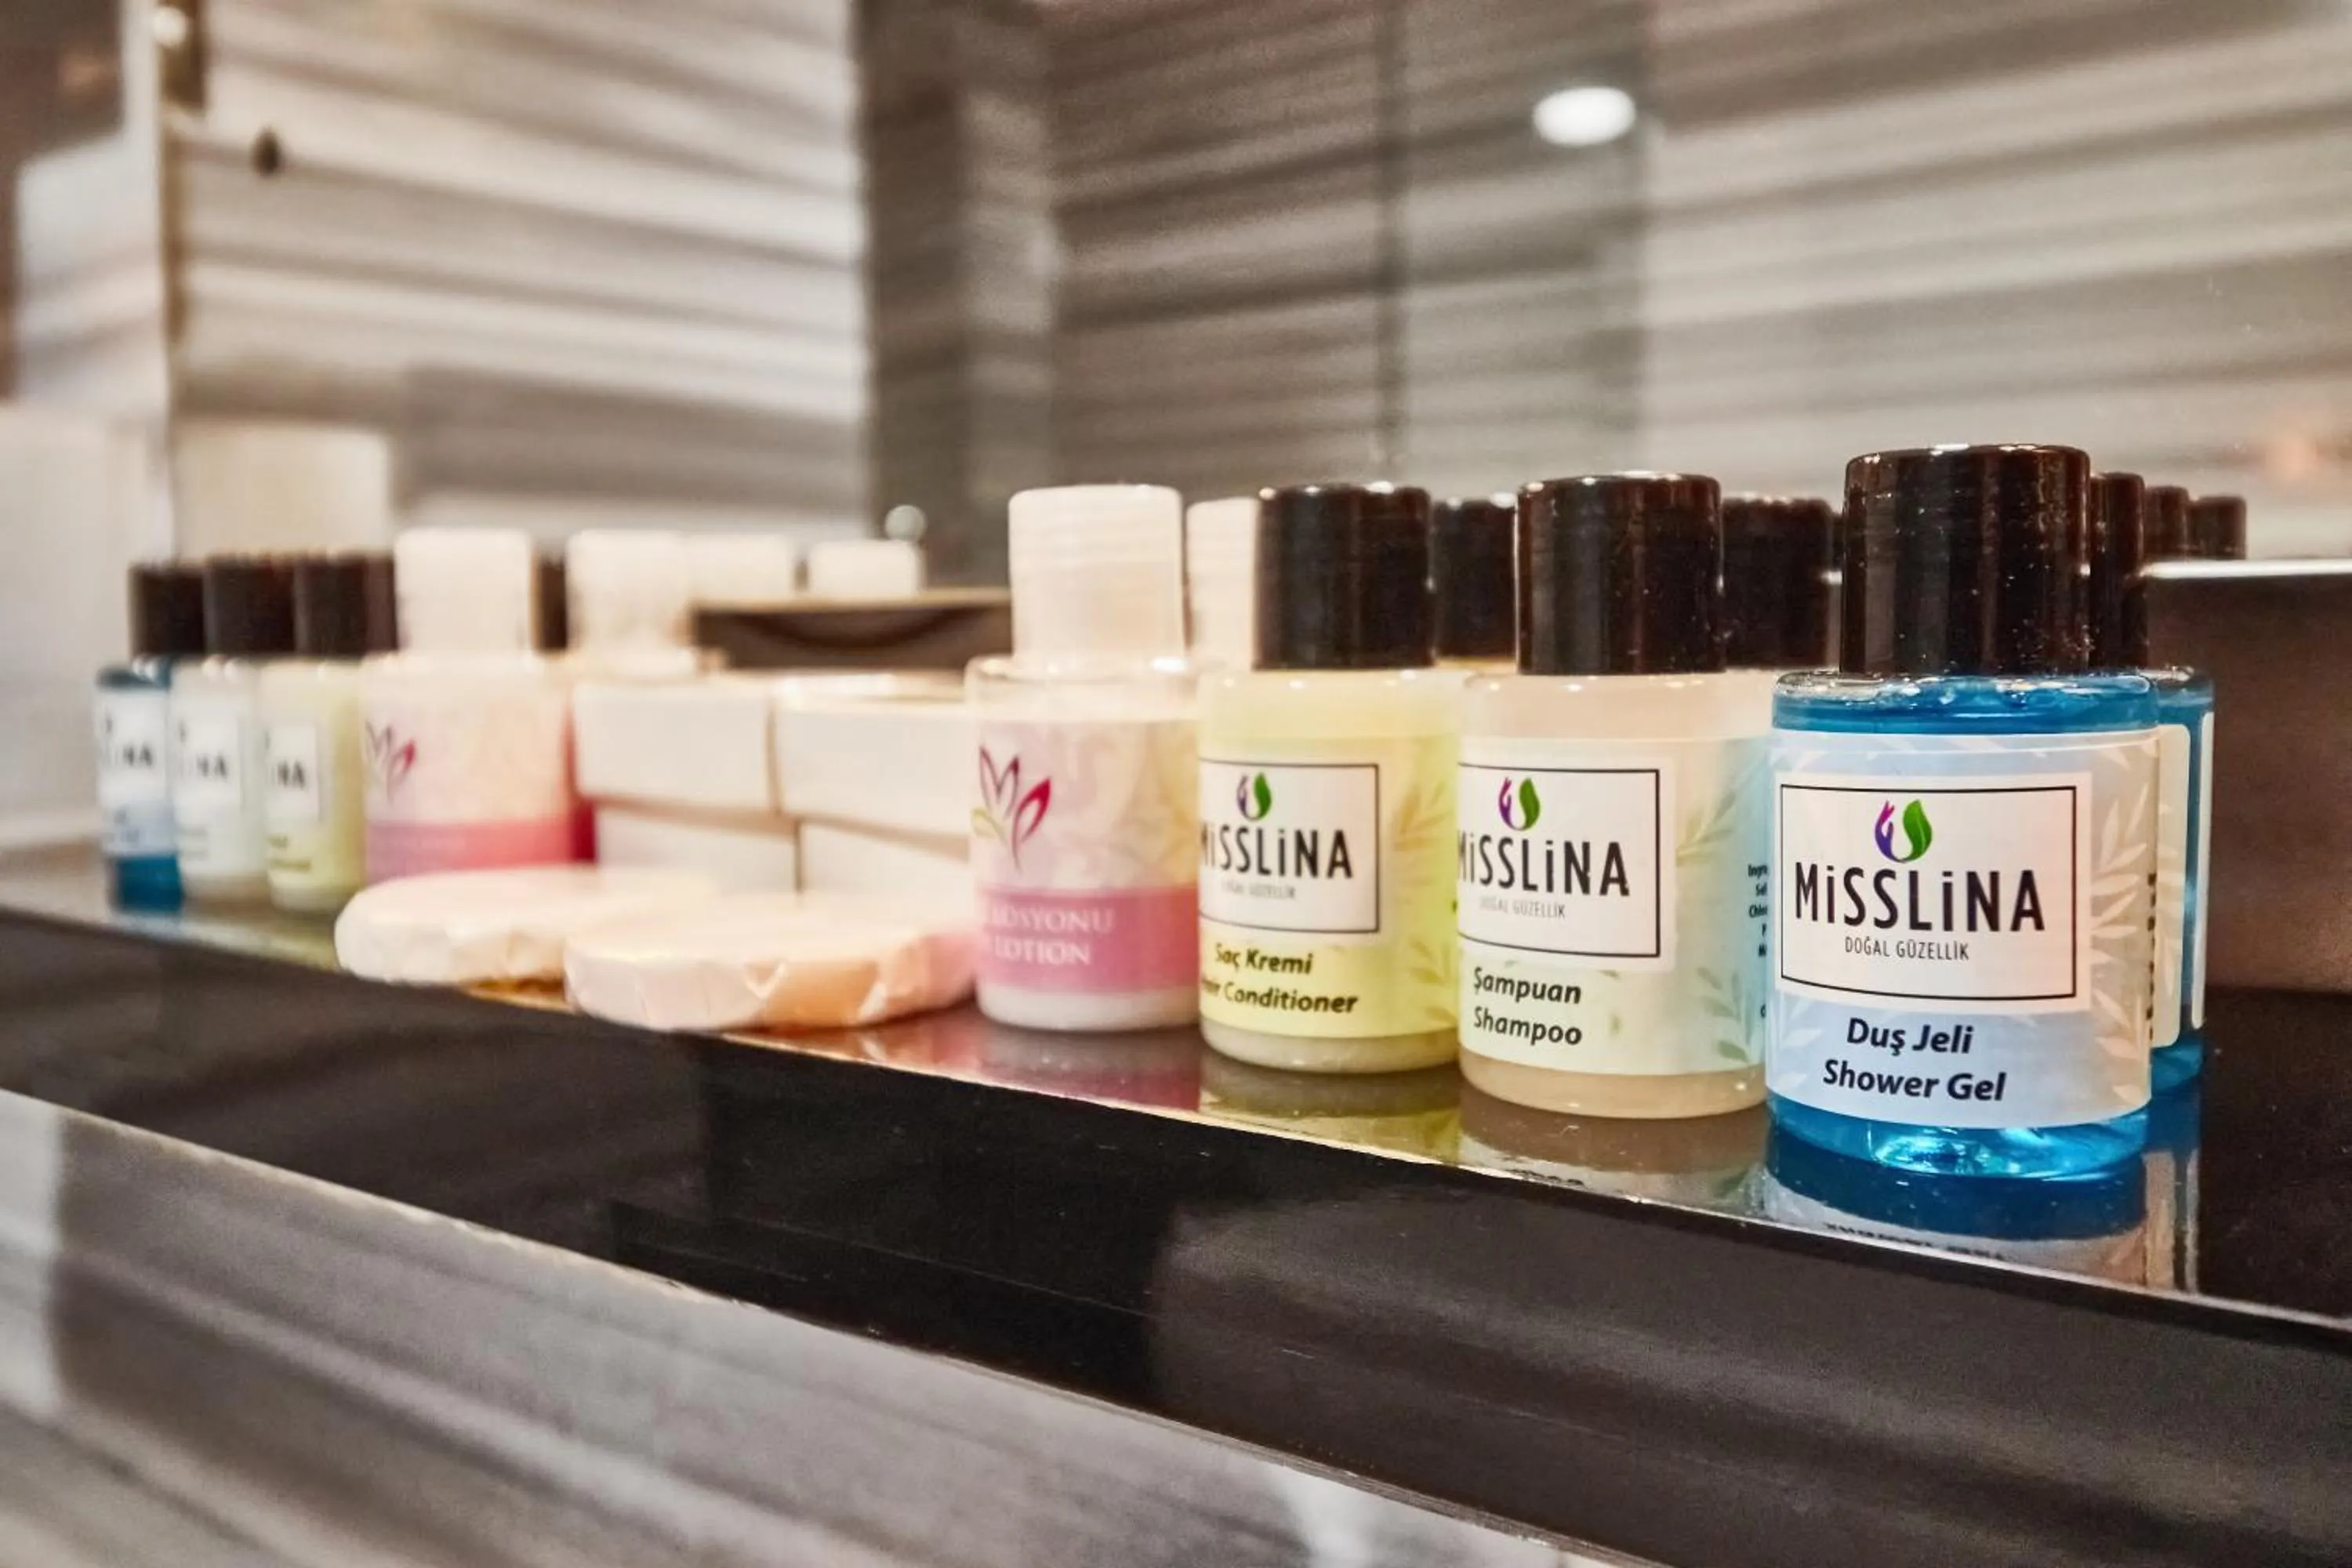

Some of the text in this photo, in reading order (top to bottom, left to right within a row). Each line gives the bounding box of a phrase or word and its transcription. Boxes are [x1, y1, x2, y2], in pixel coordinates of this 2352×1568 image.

[992, 904, 1116, 934] LOSYONU
[995, 935, 1091, 966] LOTION
[1245, 948, 1314, 975] Kremi
[1845, 935, 1969, 961] DOĞAL GÜZELLİK
[1223, 982, 1358, 1014] Conditioner
[1474, 965, 1581, 1004] Şampuan
[1474, 1006, 1582, 1046] Shampoo
[1846, 1017, 1975, 1057] Duş Jeli
[1823, 1058, 2008, 1102] Shower Gel
